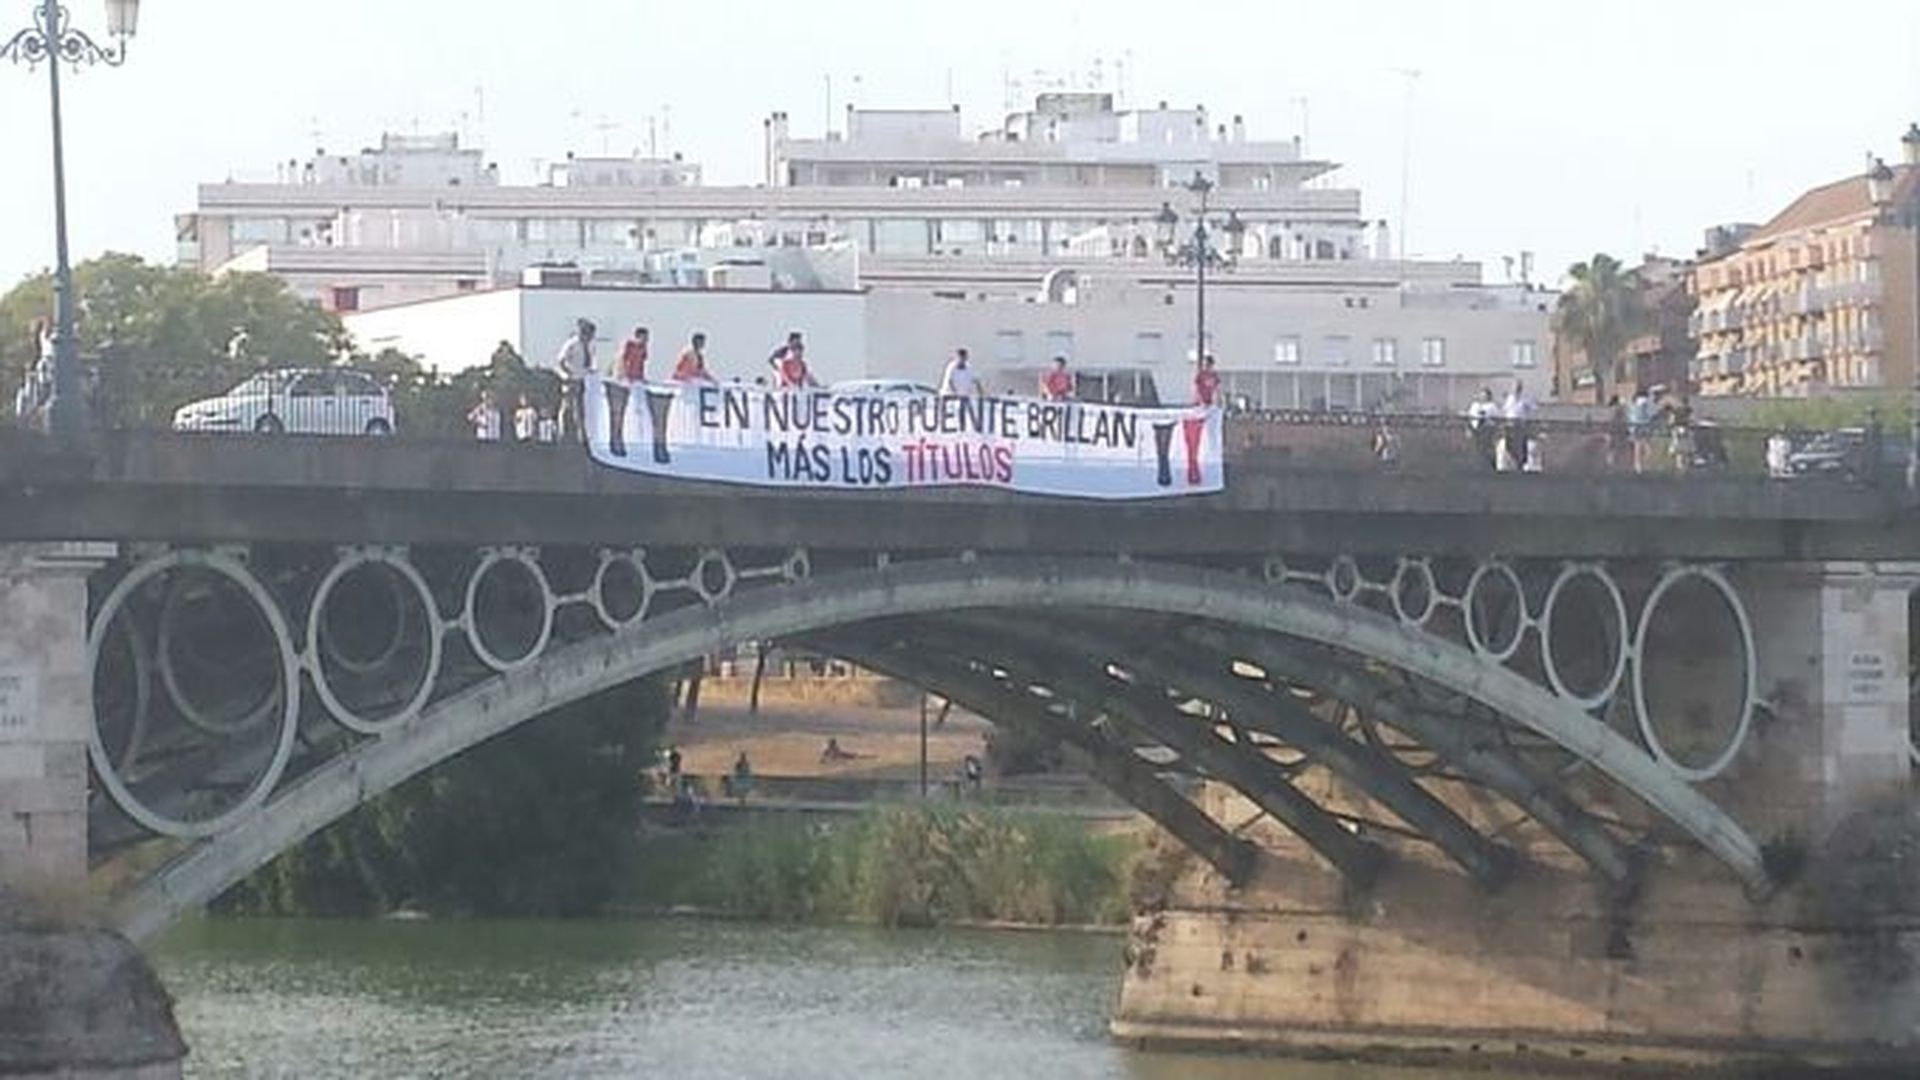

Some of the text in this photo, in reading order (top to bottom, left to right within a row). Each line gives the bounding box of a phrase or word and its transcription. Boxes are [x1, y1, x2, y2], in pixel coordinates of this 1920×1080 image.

[700, 387, 1137, 448] EN NUESTRO PUENTE BRILLAN
[767, 433, 1013, 484] MÁS LOS TÍTULOS
